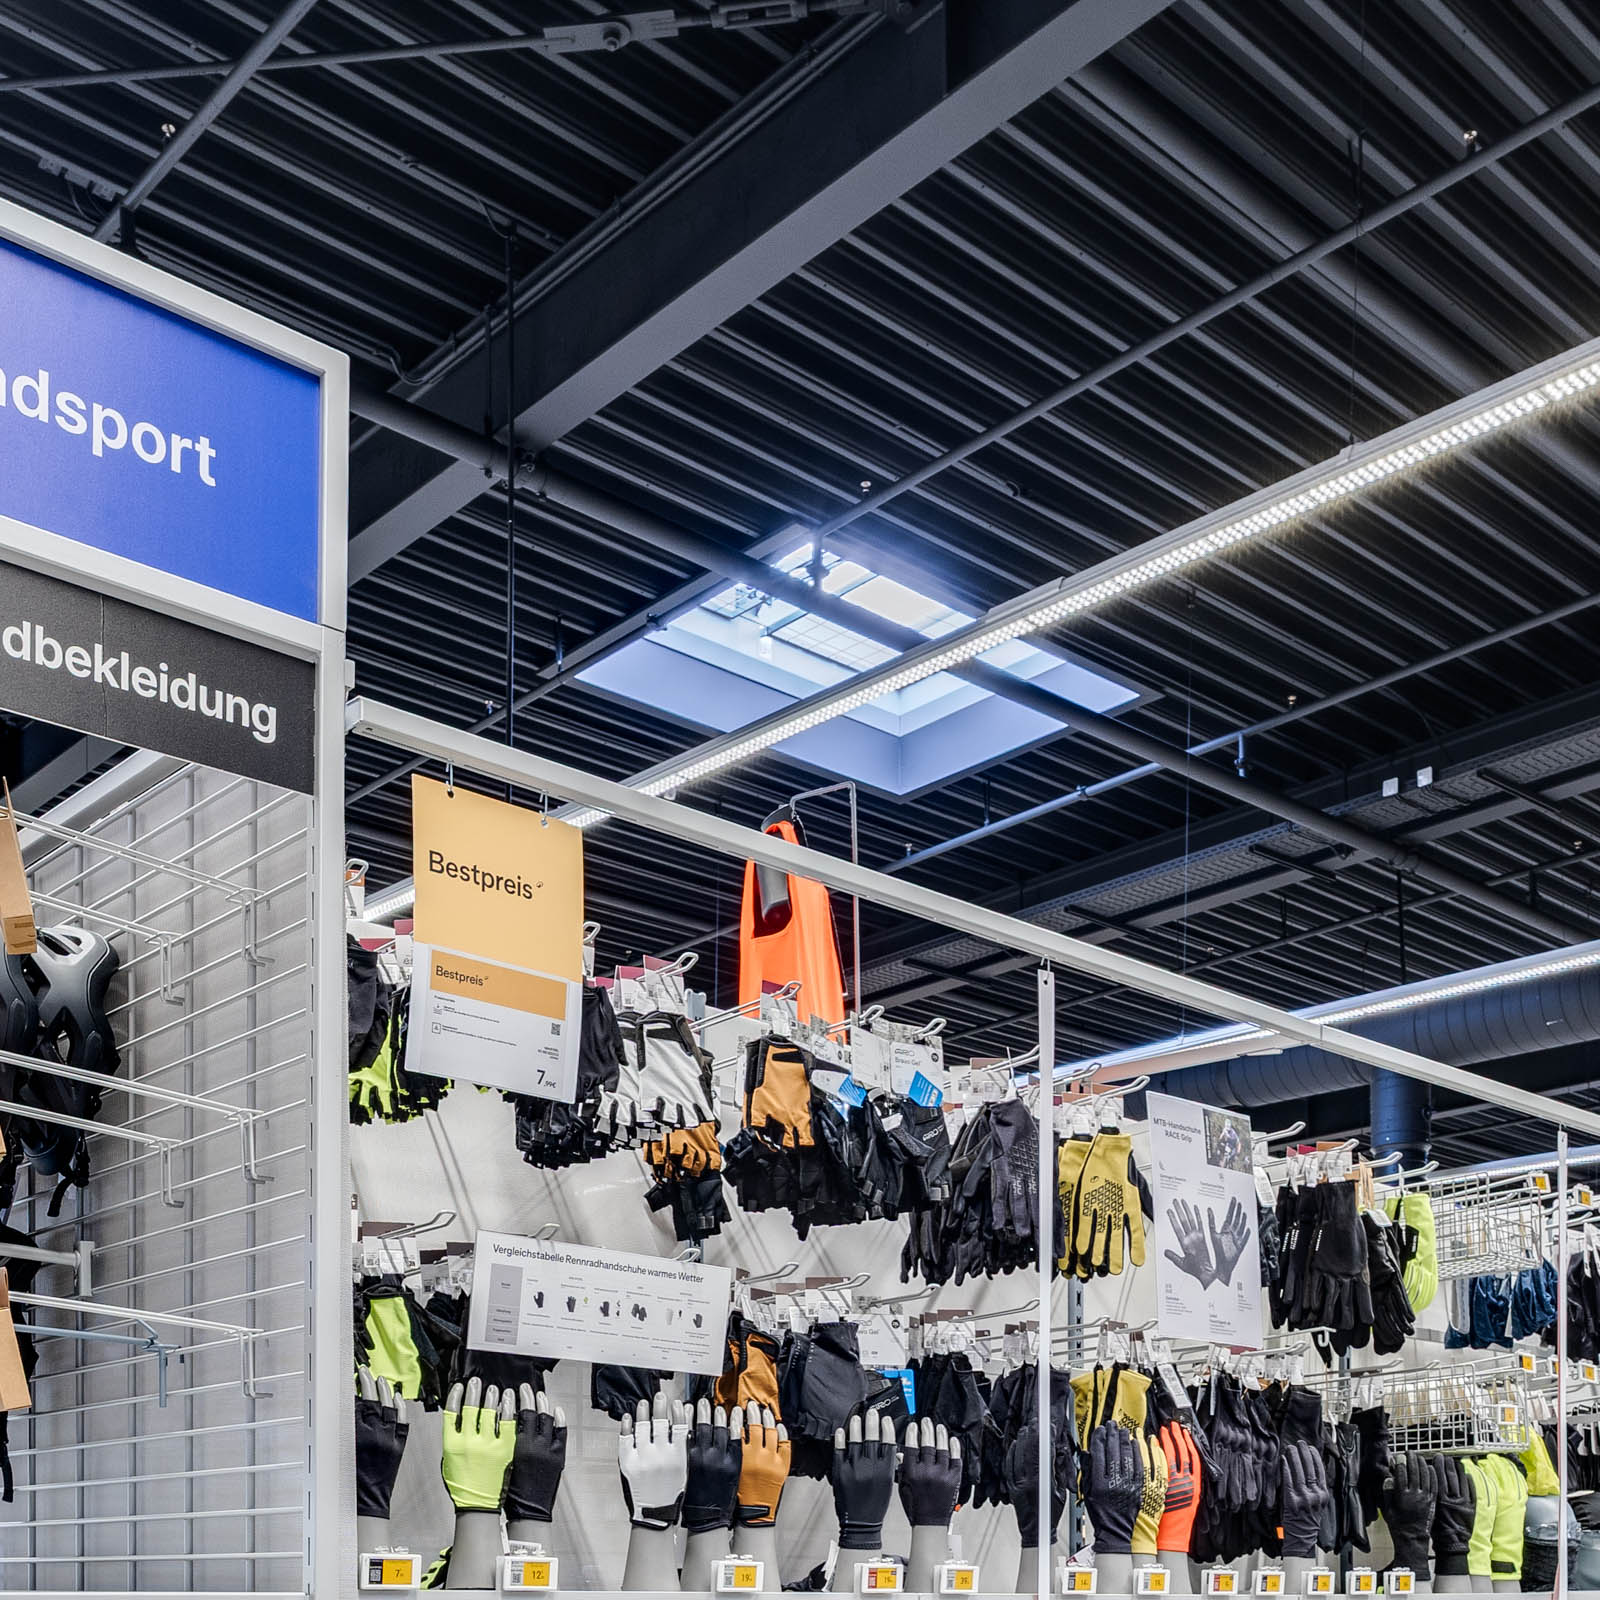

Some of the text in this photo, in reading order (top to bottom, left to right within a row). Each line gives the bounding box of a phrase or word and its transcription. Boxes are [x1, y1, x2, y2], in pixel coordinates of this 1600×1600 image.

[427, 848, 534, 901] Bestpreis
[435, 964, 484, 988] Bestpreis
[493, 1243, 704, 1284] Vergleichstabelle Rennradhandschuhe warmes Wetter
